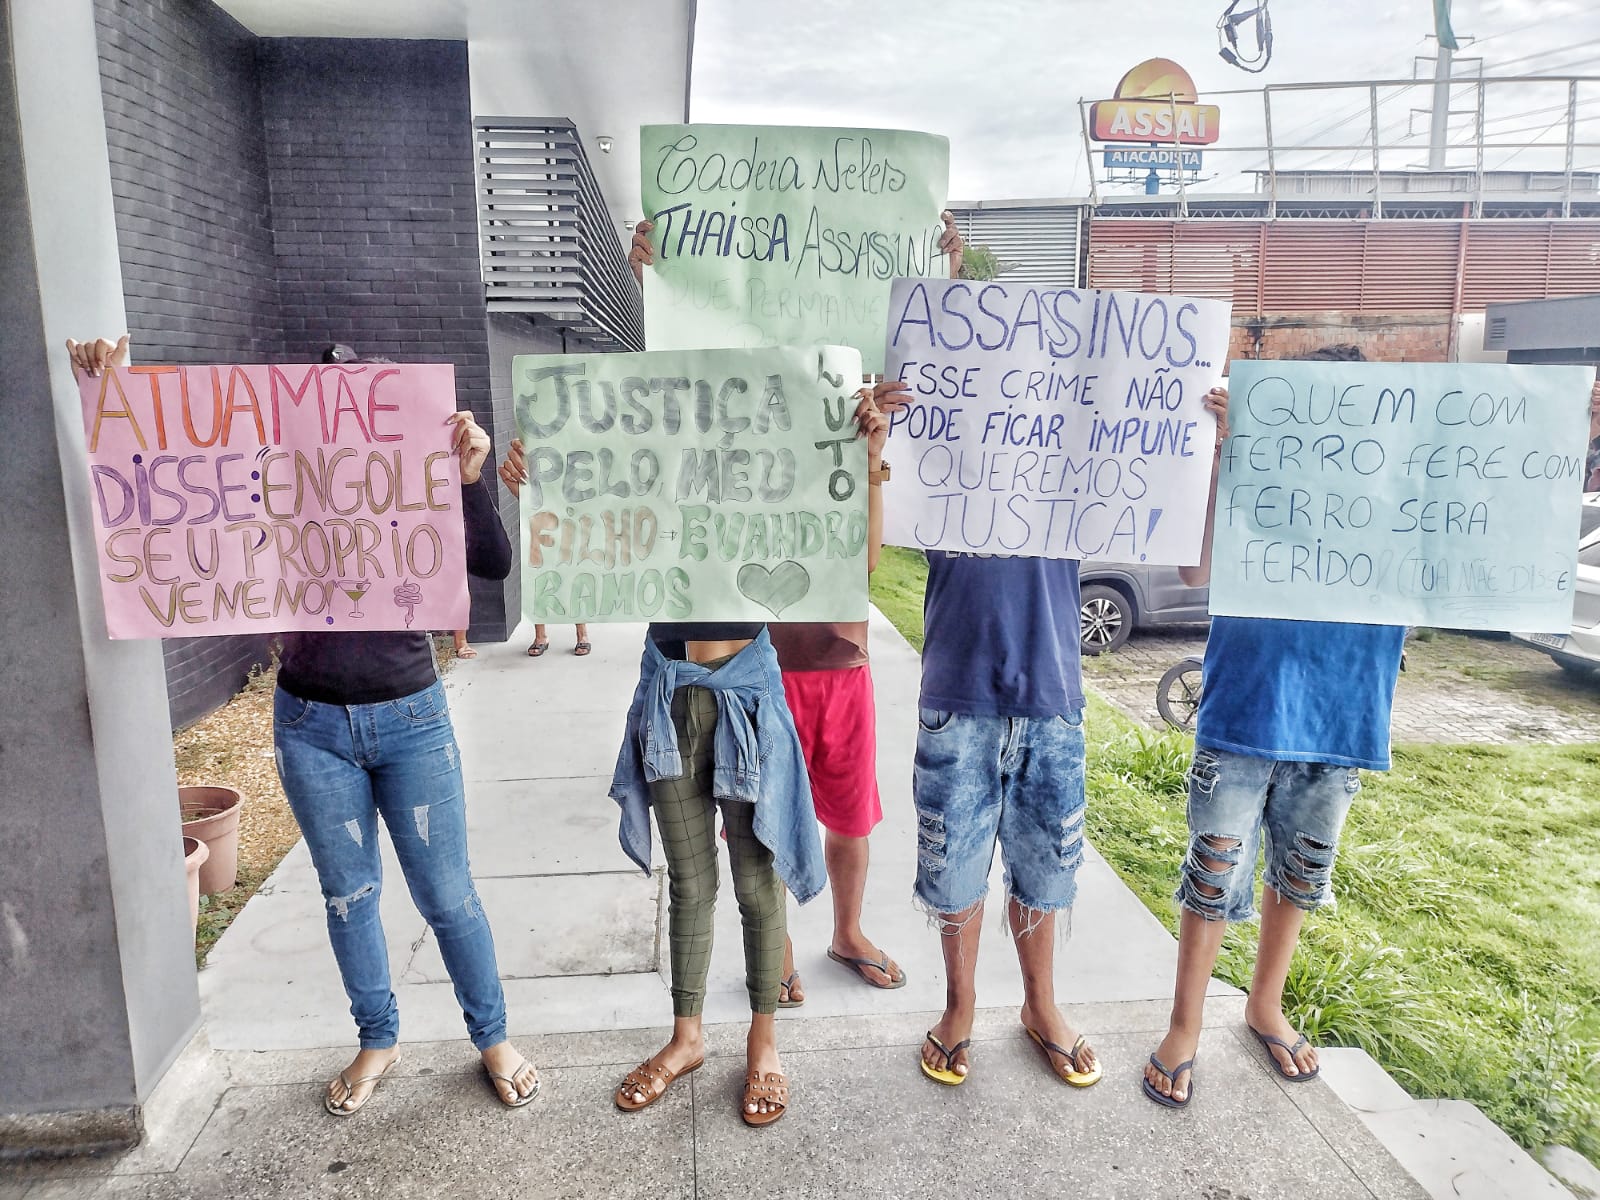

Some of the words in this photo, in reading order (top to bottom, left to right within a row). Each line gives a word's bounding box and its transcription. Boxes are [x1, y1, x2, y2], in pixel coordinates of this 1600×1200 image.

[89, 366, 149, 453] A
[128, 366, 269, 450] TUA
[268, 364, 404, 445] MÃE
[515, 362, 793, 449] JUSTIÇA
[899, 361, 981, 399] ESSE
[1125, 367, 1184, 411] NÃO
[1247, 376, 1416, 426] QUEM
[1436, 390, 1527, 426] COM
[888, 402, 963, 442] PODE
[675, 447, 796, 504] MEU
[917, 444, 1149, 500] QUEREMOS
[1522, 450, 1582, 482] COM
[679, 504, 868, 562] EVANDRO
[914, 492, 1163, 562] JUSTIÇA!
[105, 527, 221, 585] SEU
[139, 579, 336, 627] VENENO!
[533, 567, 693, 619] RAMOS
